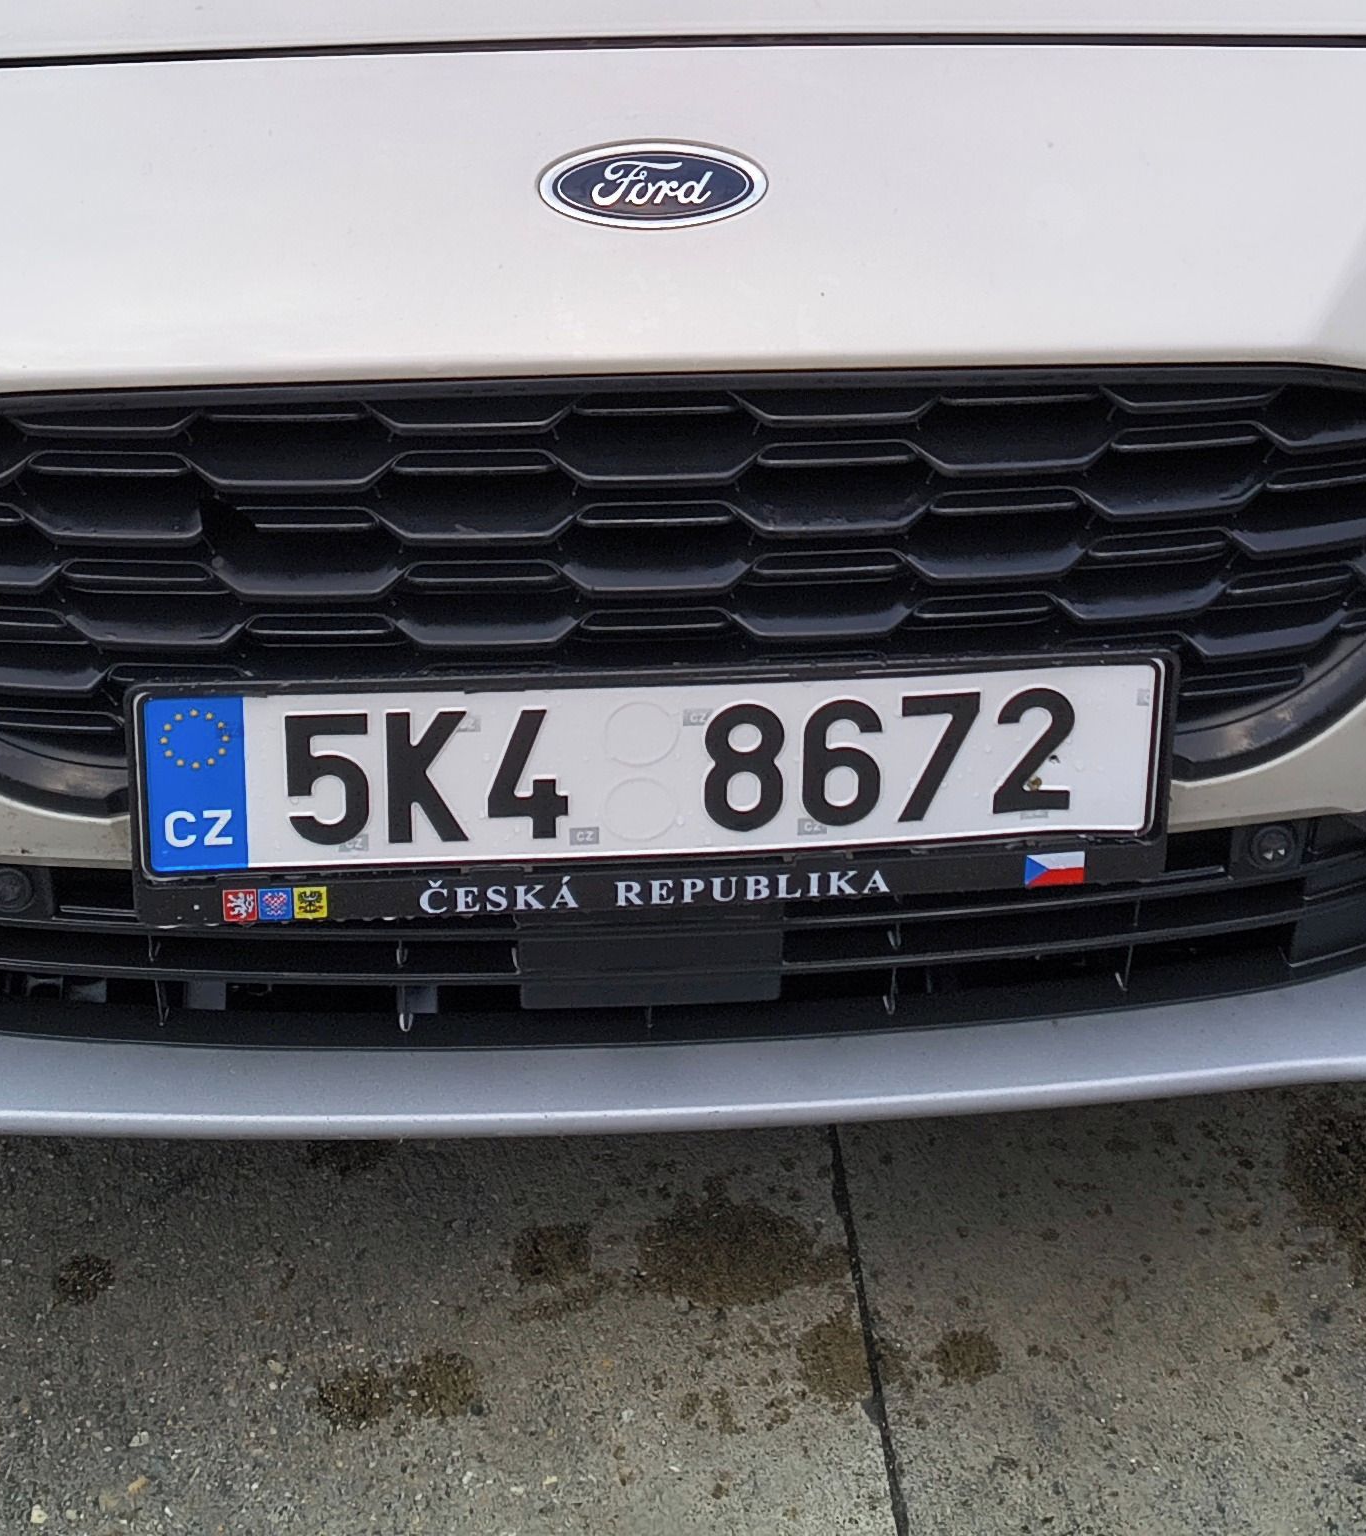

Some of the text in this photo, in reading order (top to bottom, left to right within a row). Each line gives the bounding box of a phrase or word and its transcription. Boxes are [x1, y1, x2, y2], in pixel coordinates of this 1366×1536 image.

[591, 161, 714, 207] Ford
[283, 686, 1077, 845] 5K4 8672
[164, 808, 234, 848] CZ
[419, 869, 891, 914] ČESKÁ REPUBLIKA
